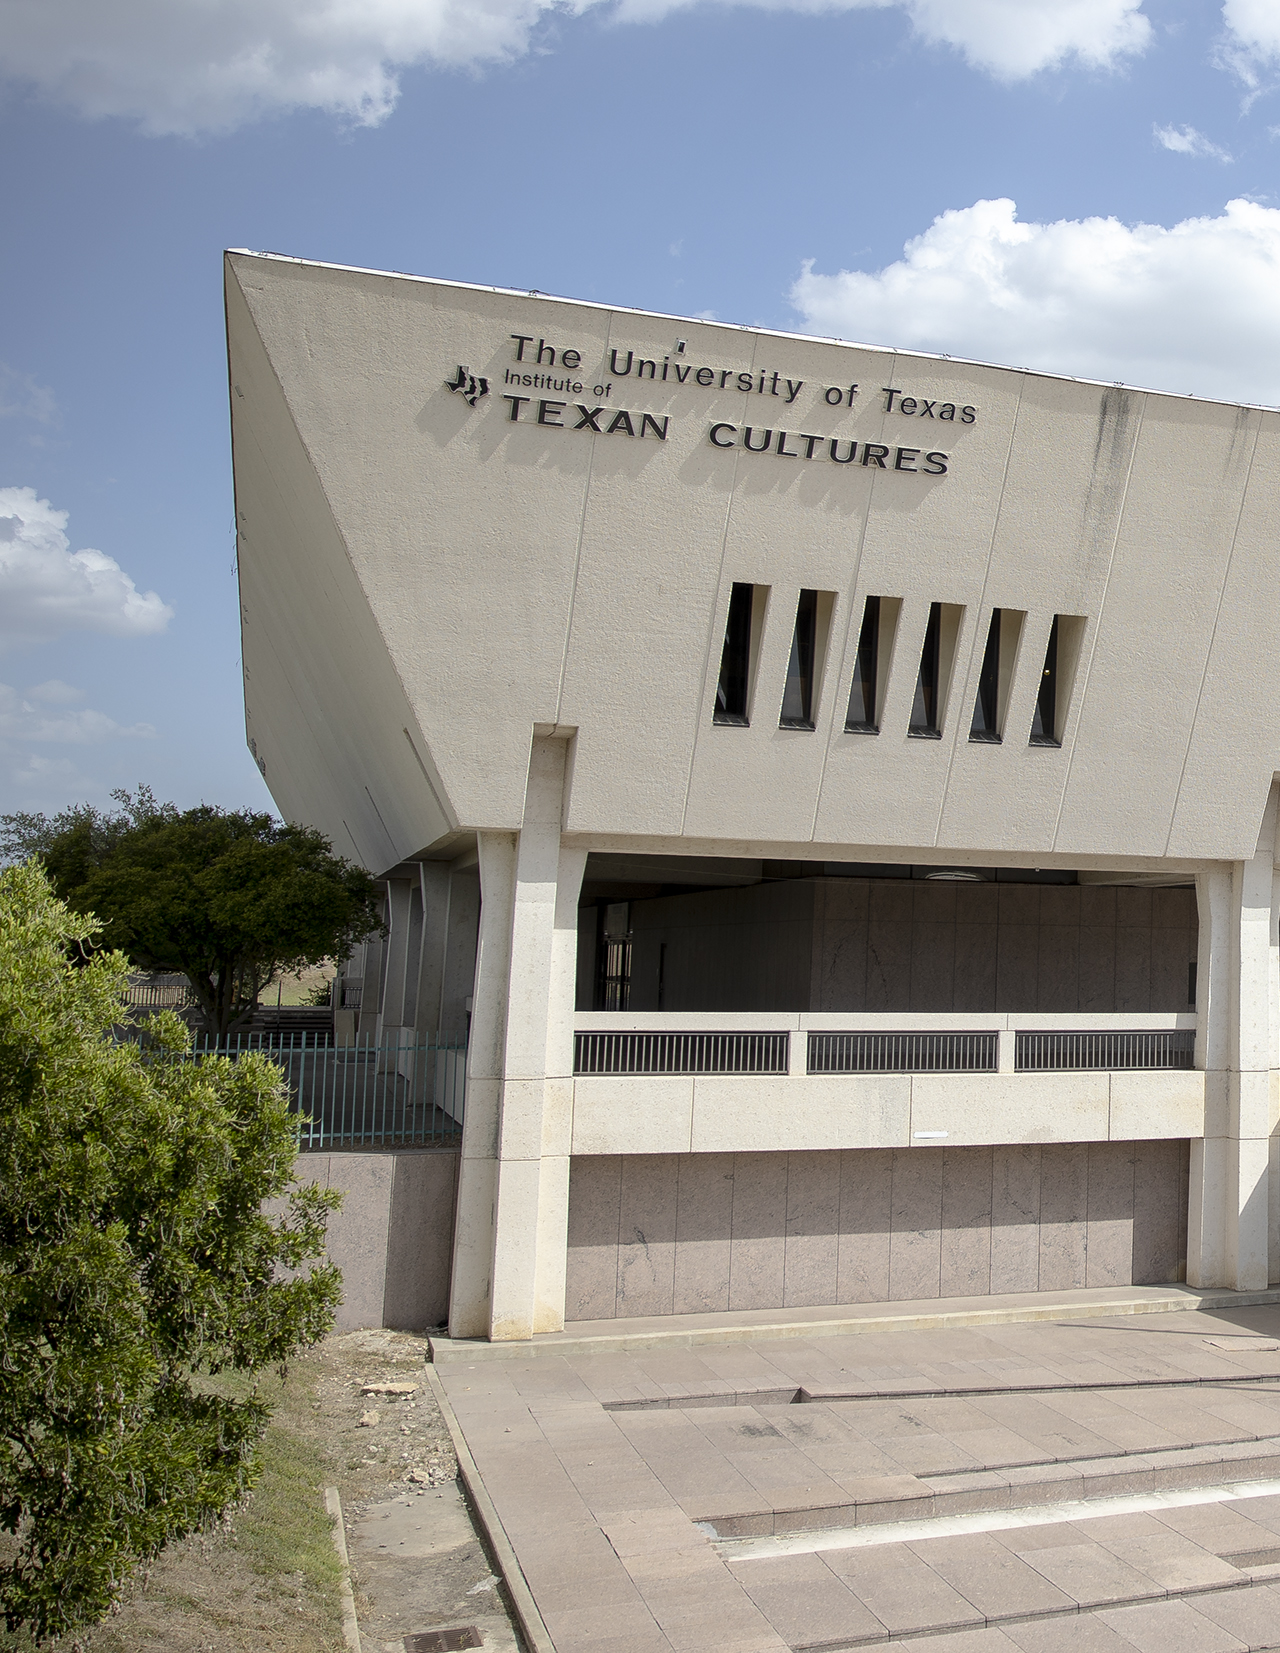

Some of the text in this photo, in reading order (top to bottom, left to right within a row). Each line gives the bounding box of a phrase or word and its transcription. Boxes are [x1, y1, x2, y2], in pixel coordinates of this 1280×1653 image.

[504, 368, 613, 398] Institute of
[510, 334, 978, 424] The University of Texas
[503, 395, 950, 475] TEXAN CULTURES
